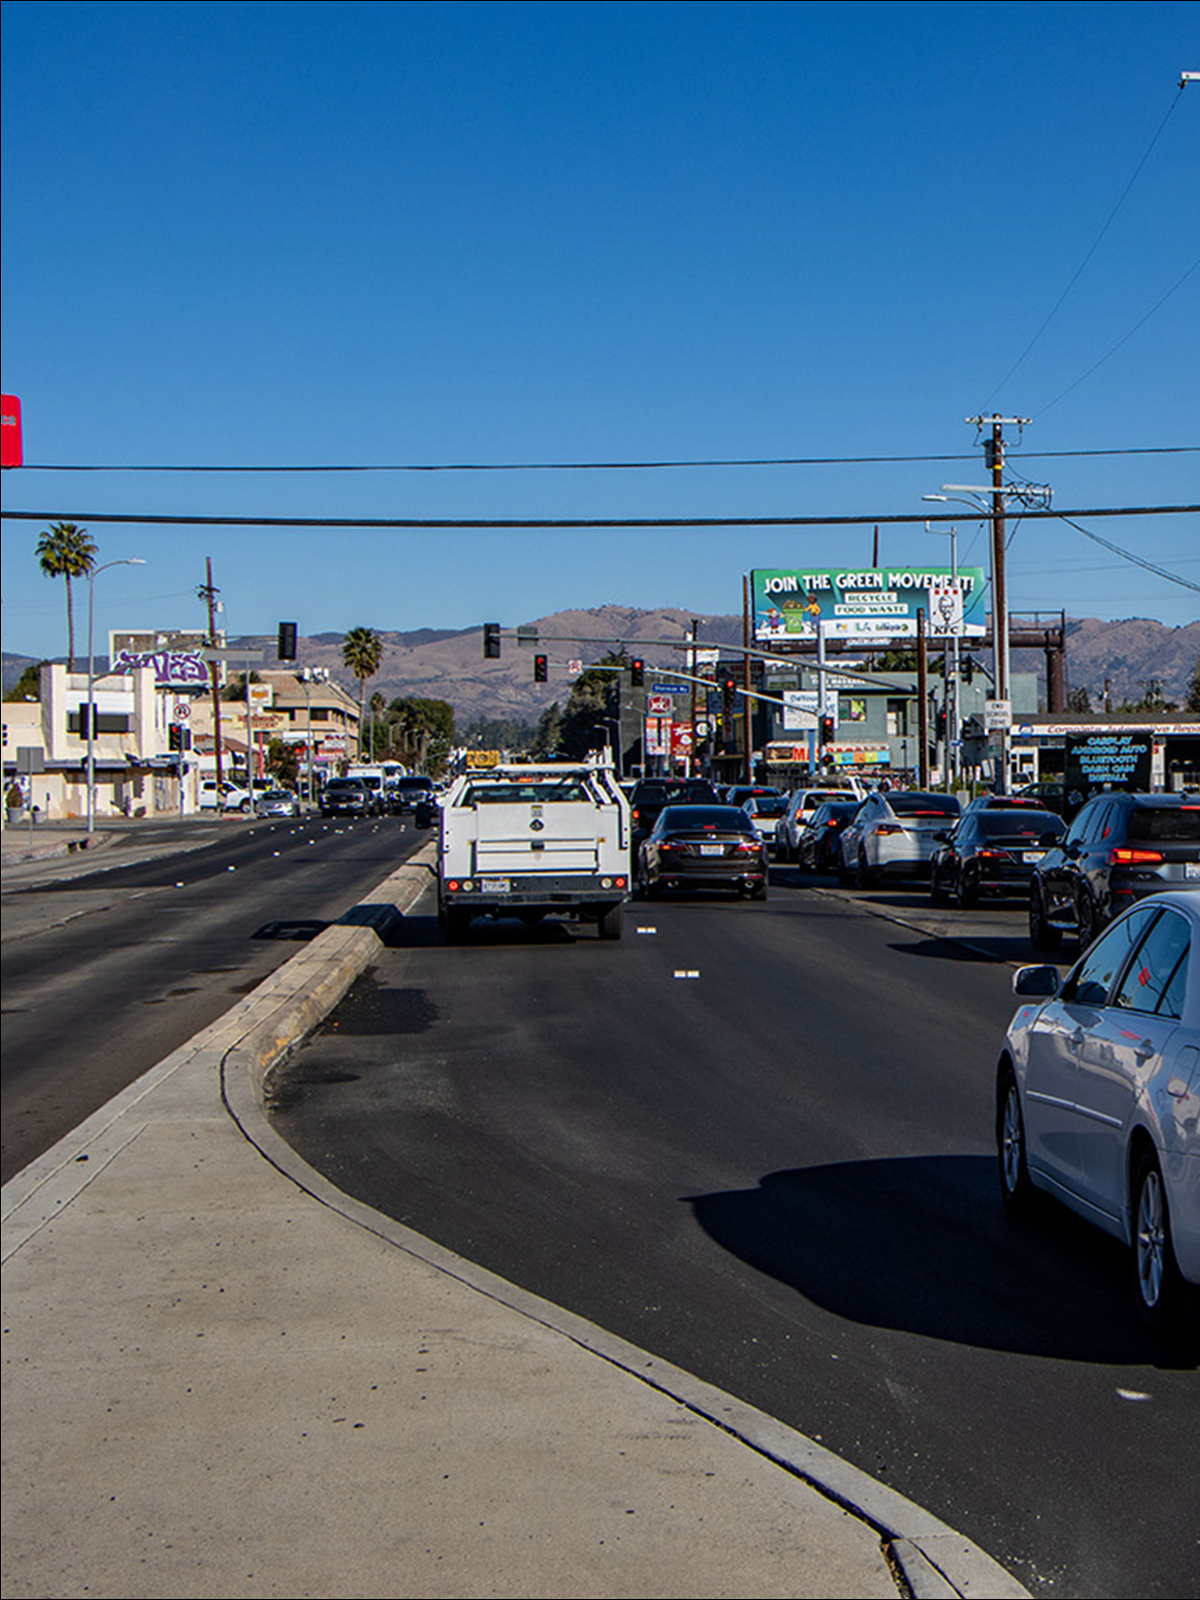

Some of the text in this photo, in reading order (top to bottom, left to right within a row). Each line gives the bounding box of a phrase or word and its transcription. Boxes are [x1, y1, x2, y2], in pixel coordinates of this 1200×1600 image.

[764, 576, 798, 594] JOIN
[802, 574, 831, 590] THE
[835, 573, 883, 588] GREEN
[847, 593, 895, 603] RECYCLE
[837, 604, 906, 614] FOOD WASTE
[934, 626, 959, 635] KFC
[1087, 735, 1133, 746] CARPLAY
[1070, 744, 1147, 755] ANDROID AUTO
[1079, 755, 1138, 765] BLUETOOTH
[1082, 763, 1135, 774] DASH CAM
[1088, 773, 1129, 783] INSTALL
